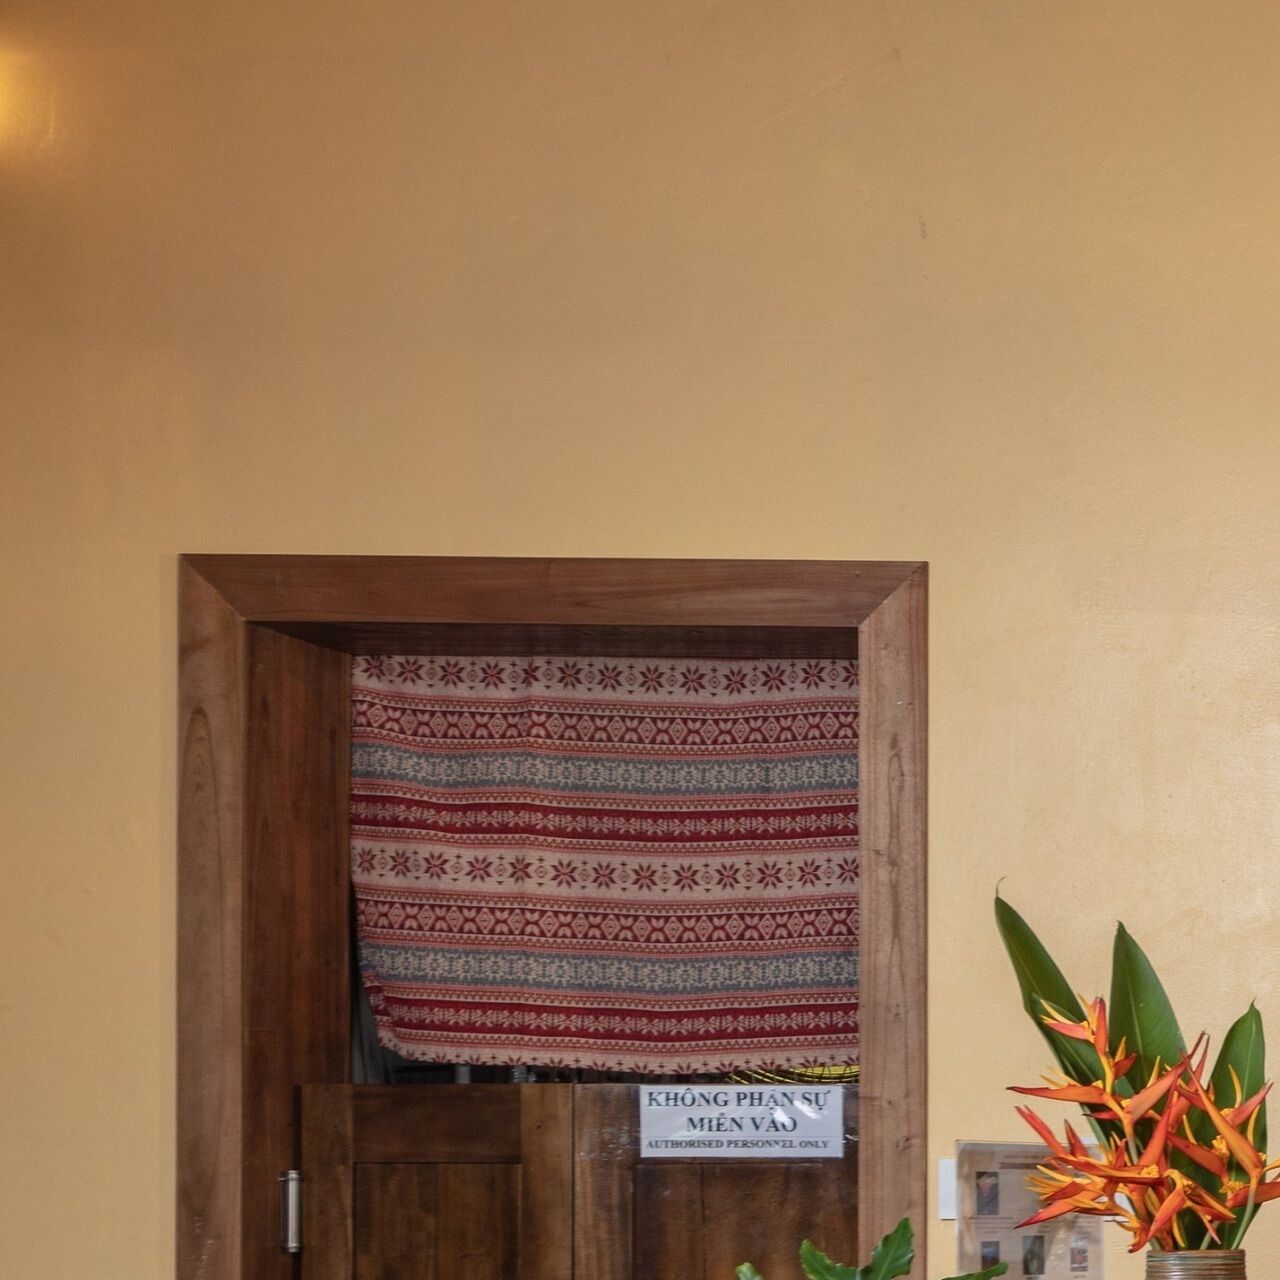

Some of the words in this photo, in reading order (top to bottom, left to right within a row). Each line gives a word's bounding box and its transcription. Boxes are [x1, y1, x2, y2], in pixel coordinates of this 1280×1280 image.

[648, 1088, 729, 1107] KHÔNG
[802, 1090, 831, 1110] SỰ
[647, 1140, 724, 1148] AUTHORISED
[726, 1140, 797, 1148] PERSONNEL
[799, 1140, 830, 1149] ONLY
